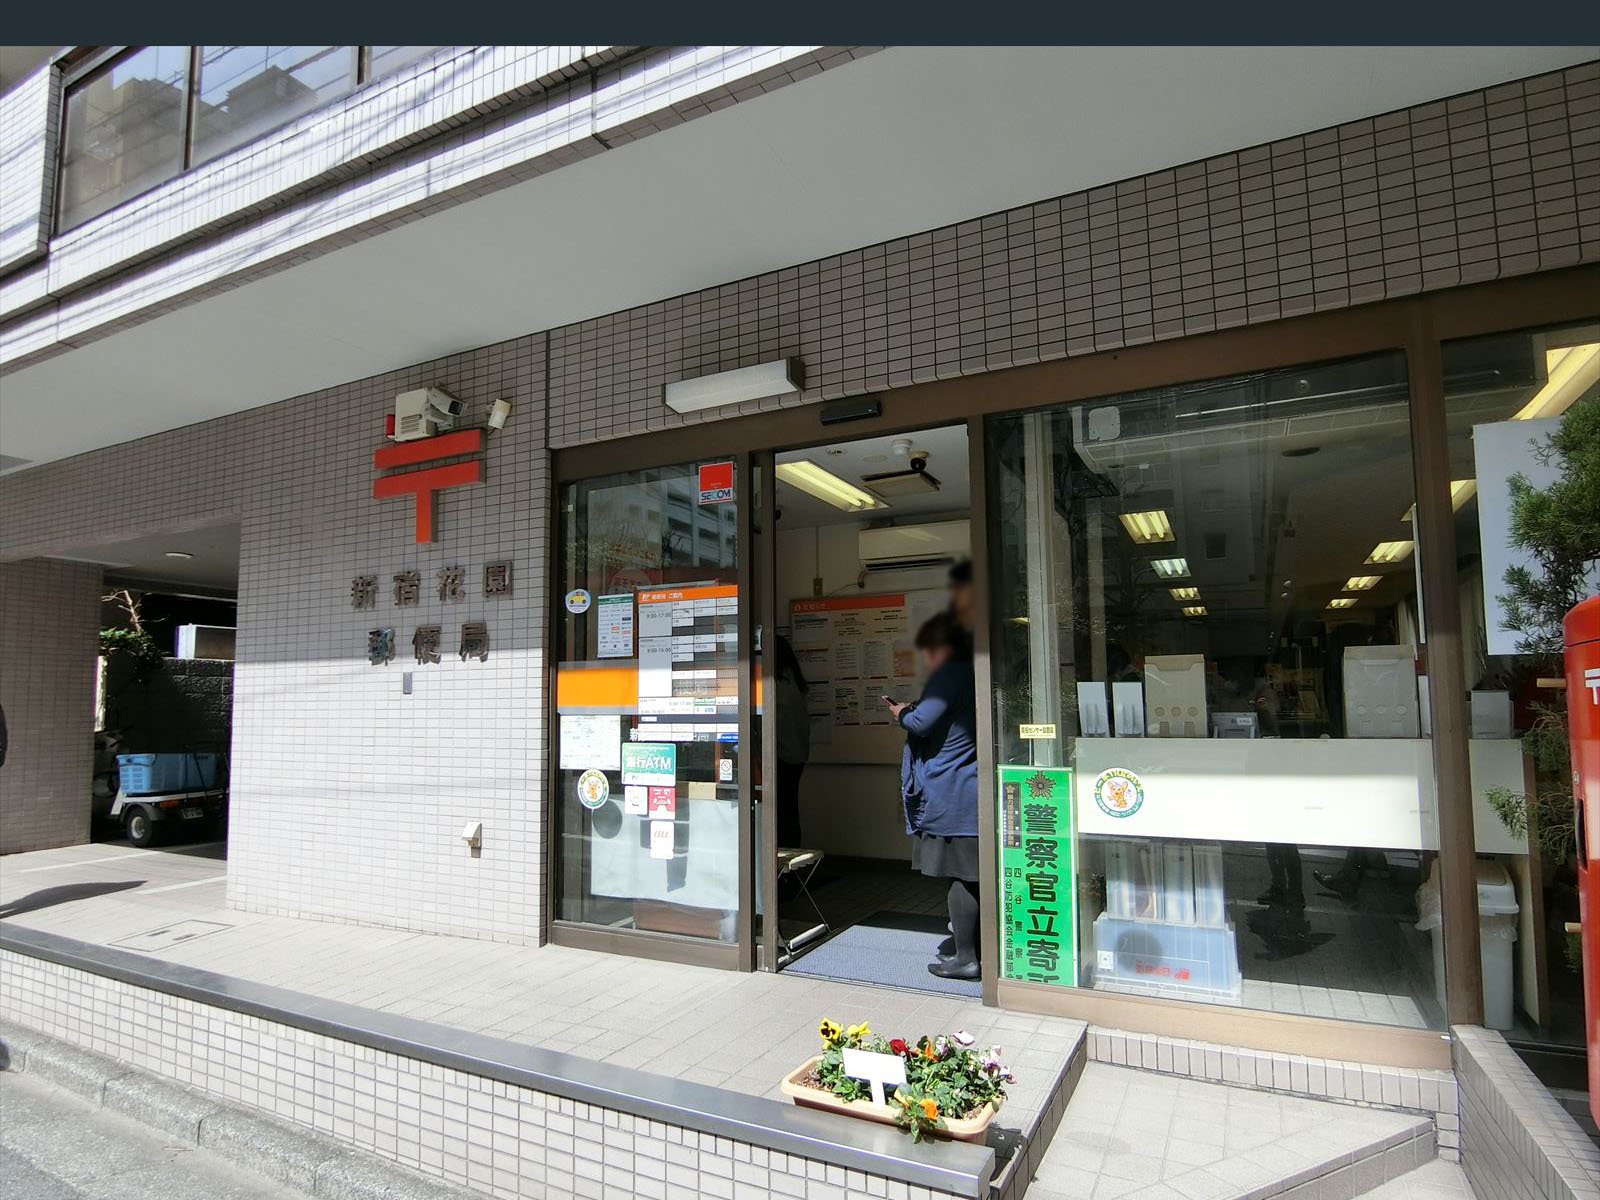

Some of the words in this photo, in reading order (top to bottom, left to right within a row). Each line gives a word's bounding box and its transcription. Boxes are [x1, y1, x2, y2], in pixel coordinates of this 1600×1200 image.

[700, 489, 731, 501] SECOM
[351, 560, 514, 610] 新宿花園
[368, 621, 489, 666] 郵便局
